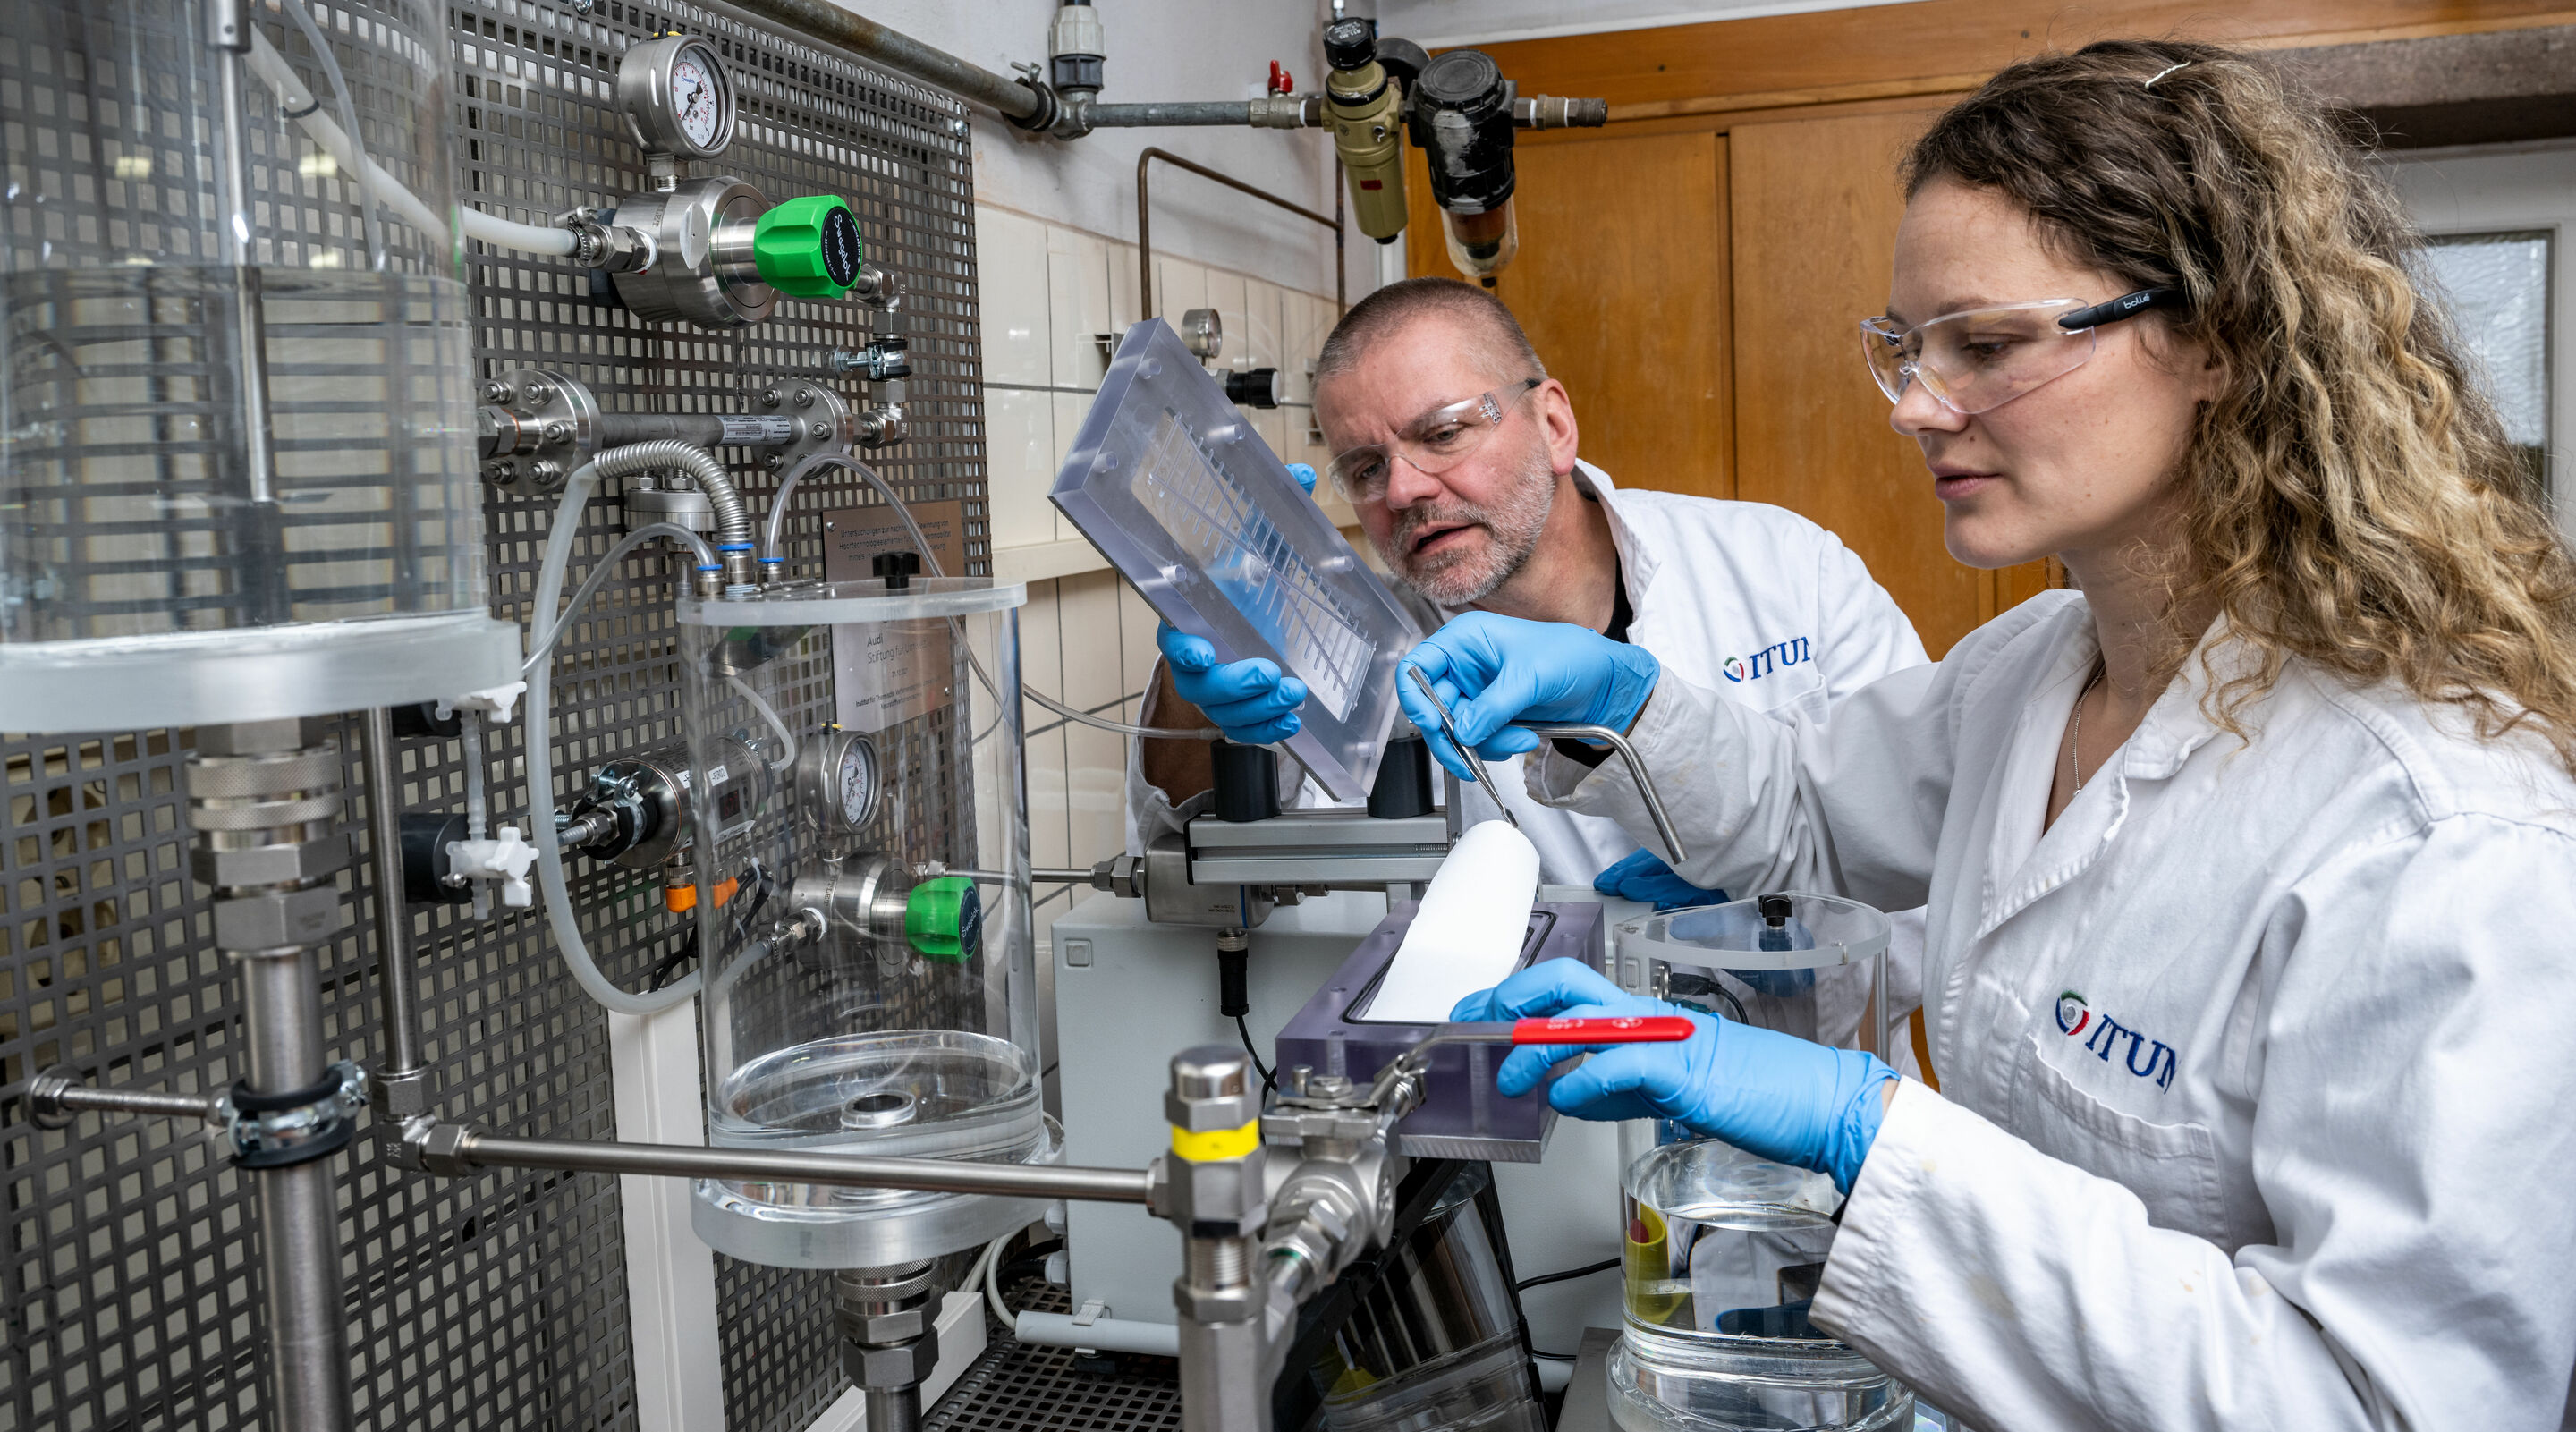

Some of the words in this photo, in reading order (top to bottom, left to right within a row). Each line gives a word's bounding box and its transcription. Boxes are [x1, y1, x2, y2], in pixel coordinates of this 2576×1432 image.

[834, 214, 851, 282] Swagelok
[2123, 292, 2150, 309] bollé
[867, 633, 884, 648] Audi
[867, 648, 894, 664] Stiftung
[961, 906, 979, 938] Swagelok
